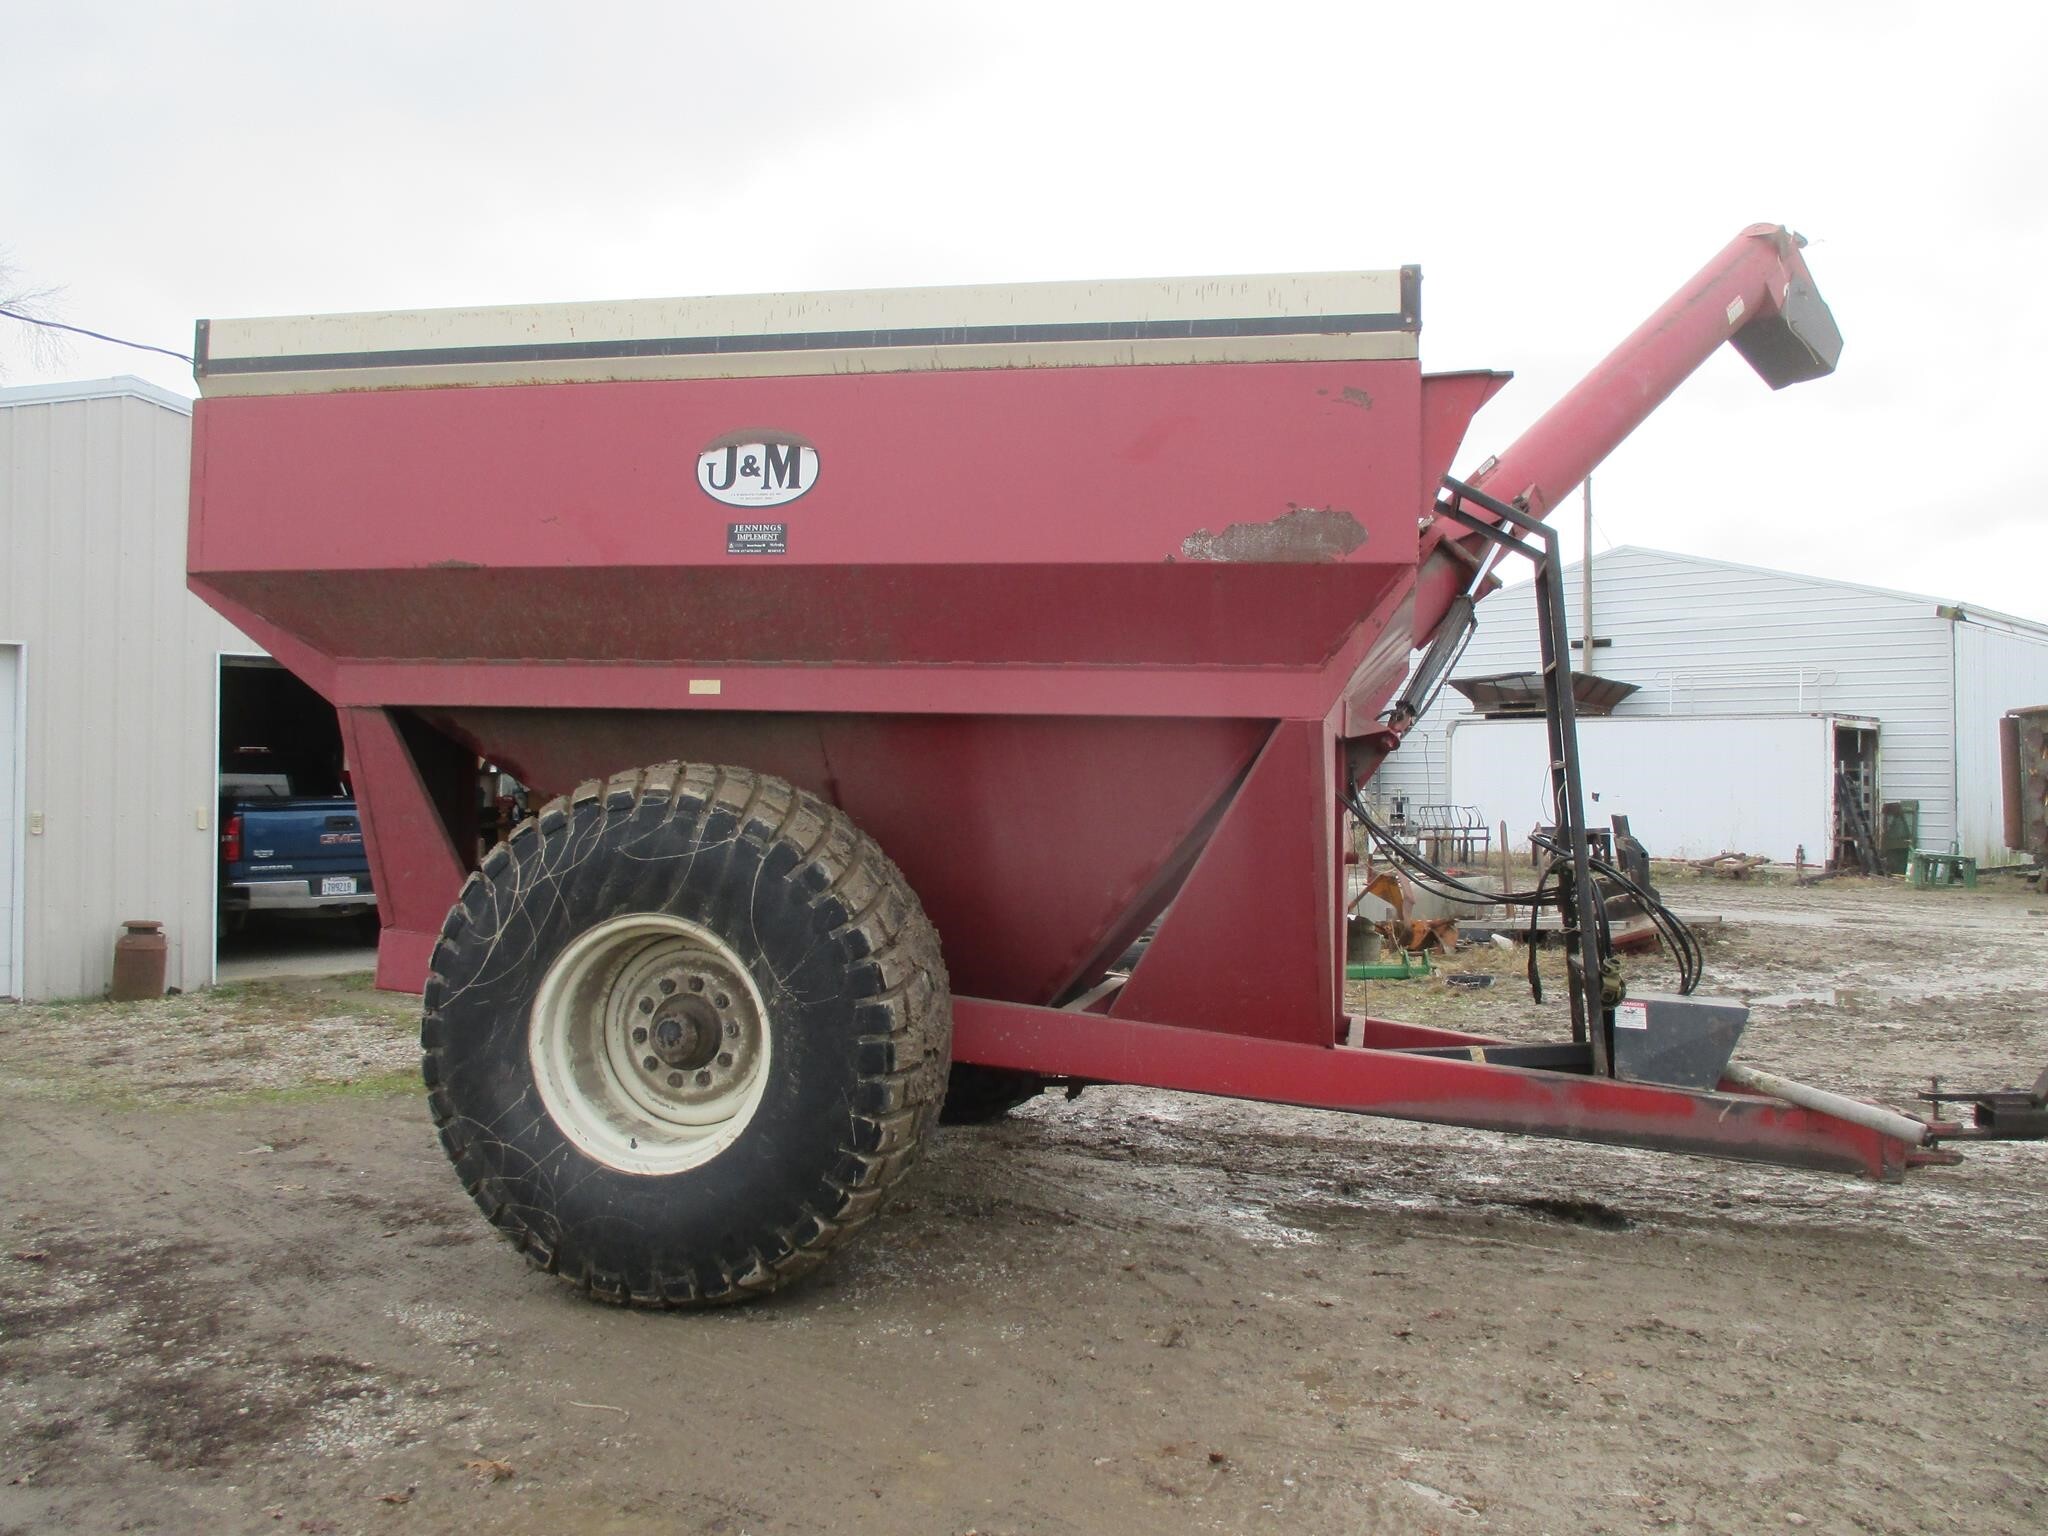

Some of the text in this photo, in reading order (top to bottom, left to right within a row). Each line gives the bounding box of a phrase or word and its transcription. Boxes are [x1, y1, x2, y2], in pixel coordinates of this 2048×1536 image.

[706, 443, 802, 490] J&M
[734, 524, 782, 533] JENNINGS
[737, 533, 779, 541] IMPLEMENT
[320, 833, 361, 845] GMC
